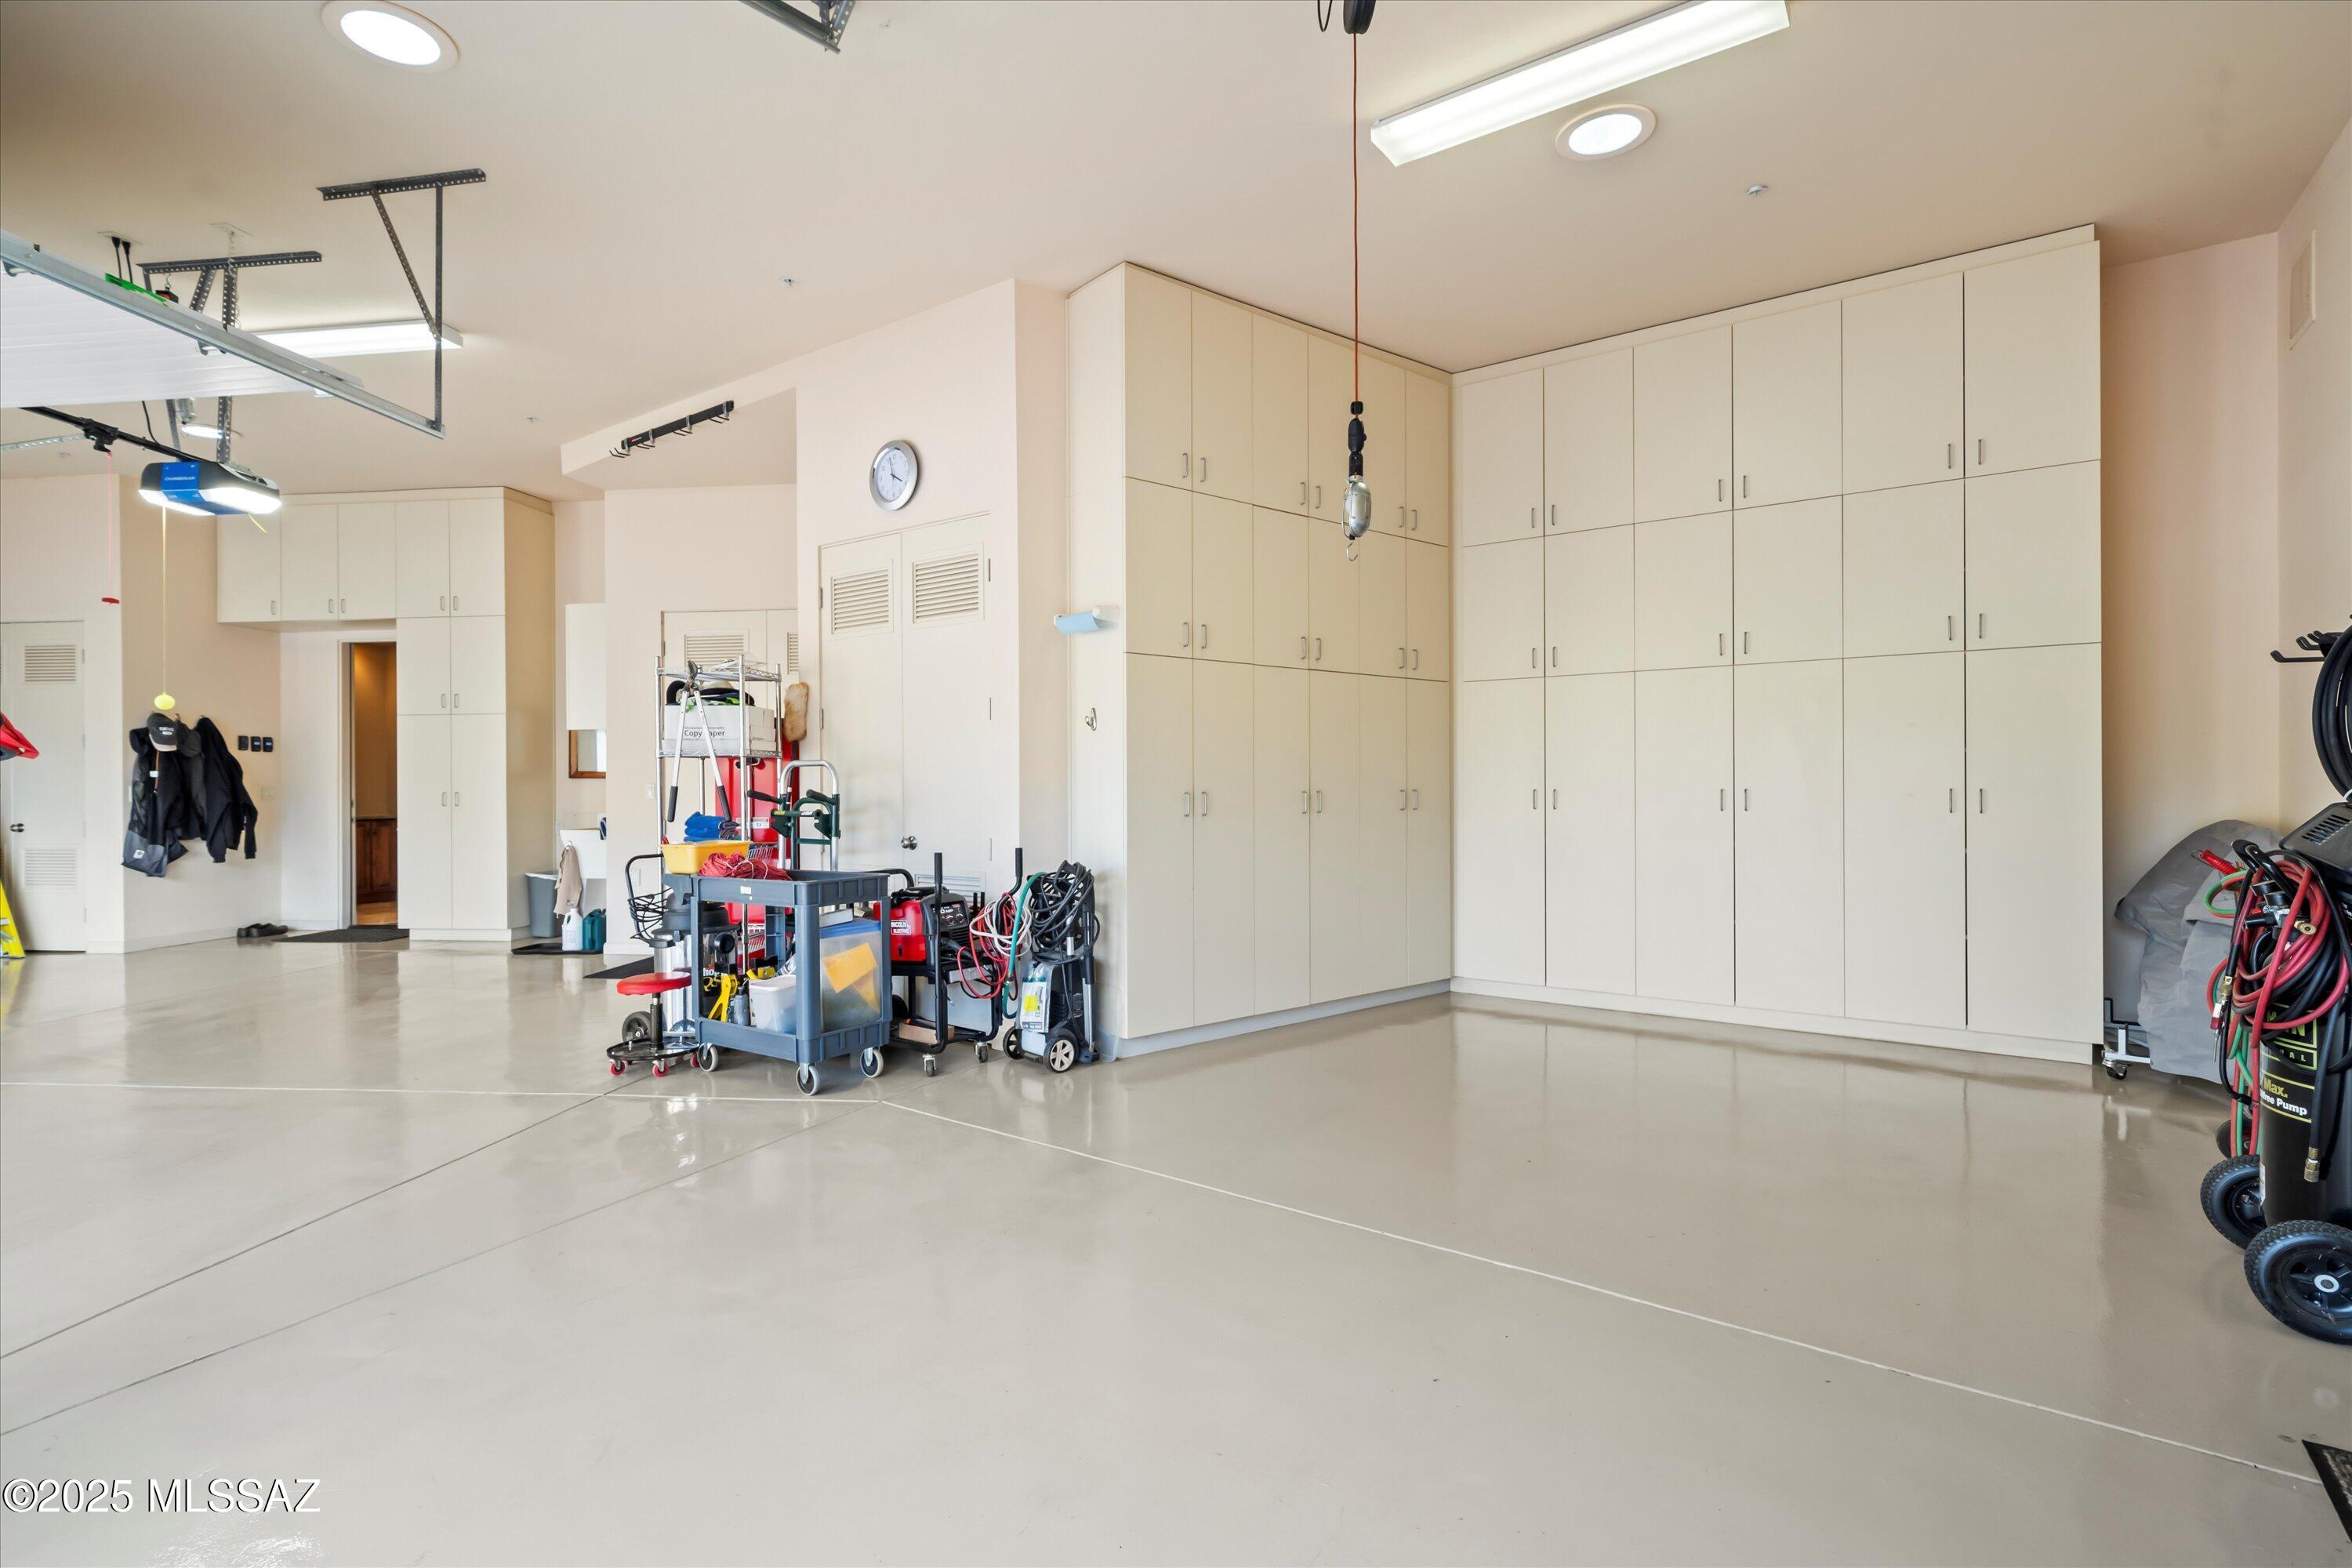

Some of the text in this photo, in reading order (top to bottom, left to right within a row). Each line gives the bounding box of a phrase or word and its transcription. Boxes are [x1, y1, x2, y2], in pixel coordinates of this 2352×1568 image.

[684, 729, 702, 738] Copy
[2263, 1076, 2288, 1098] Max.
[2276, 1097, 2308, 1116] Pump
